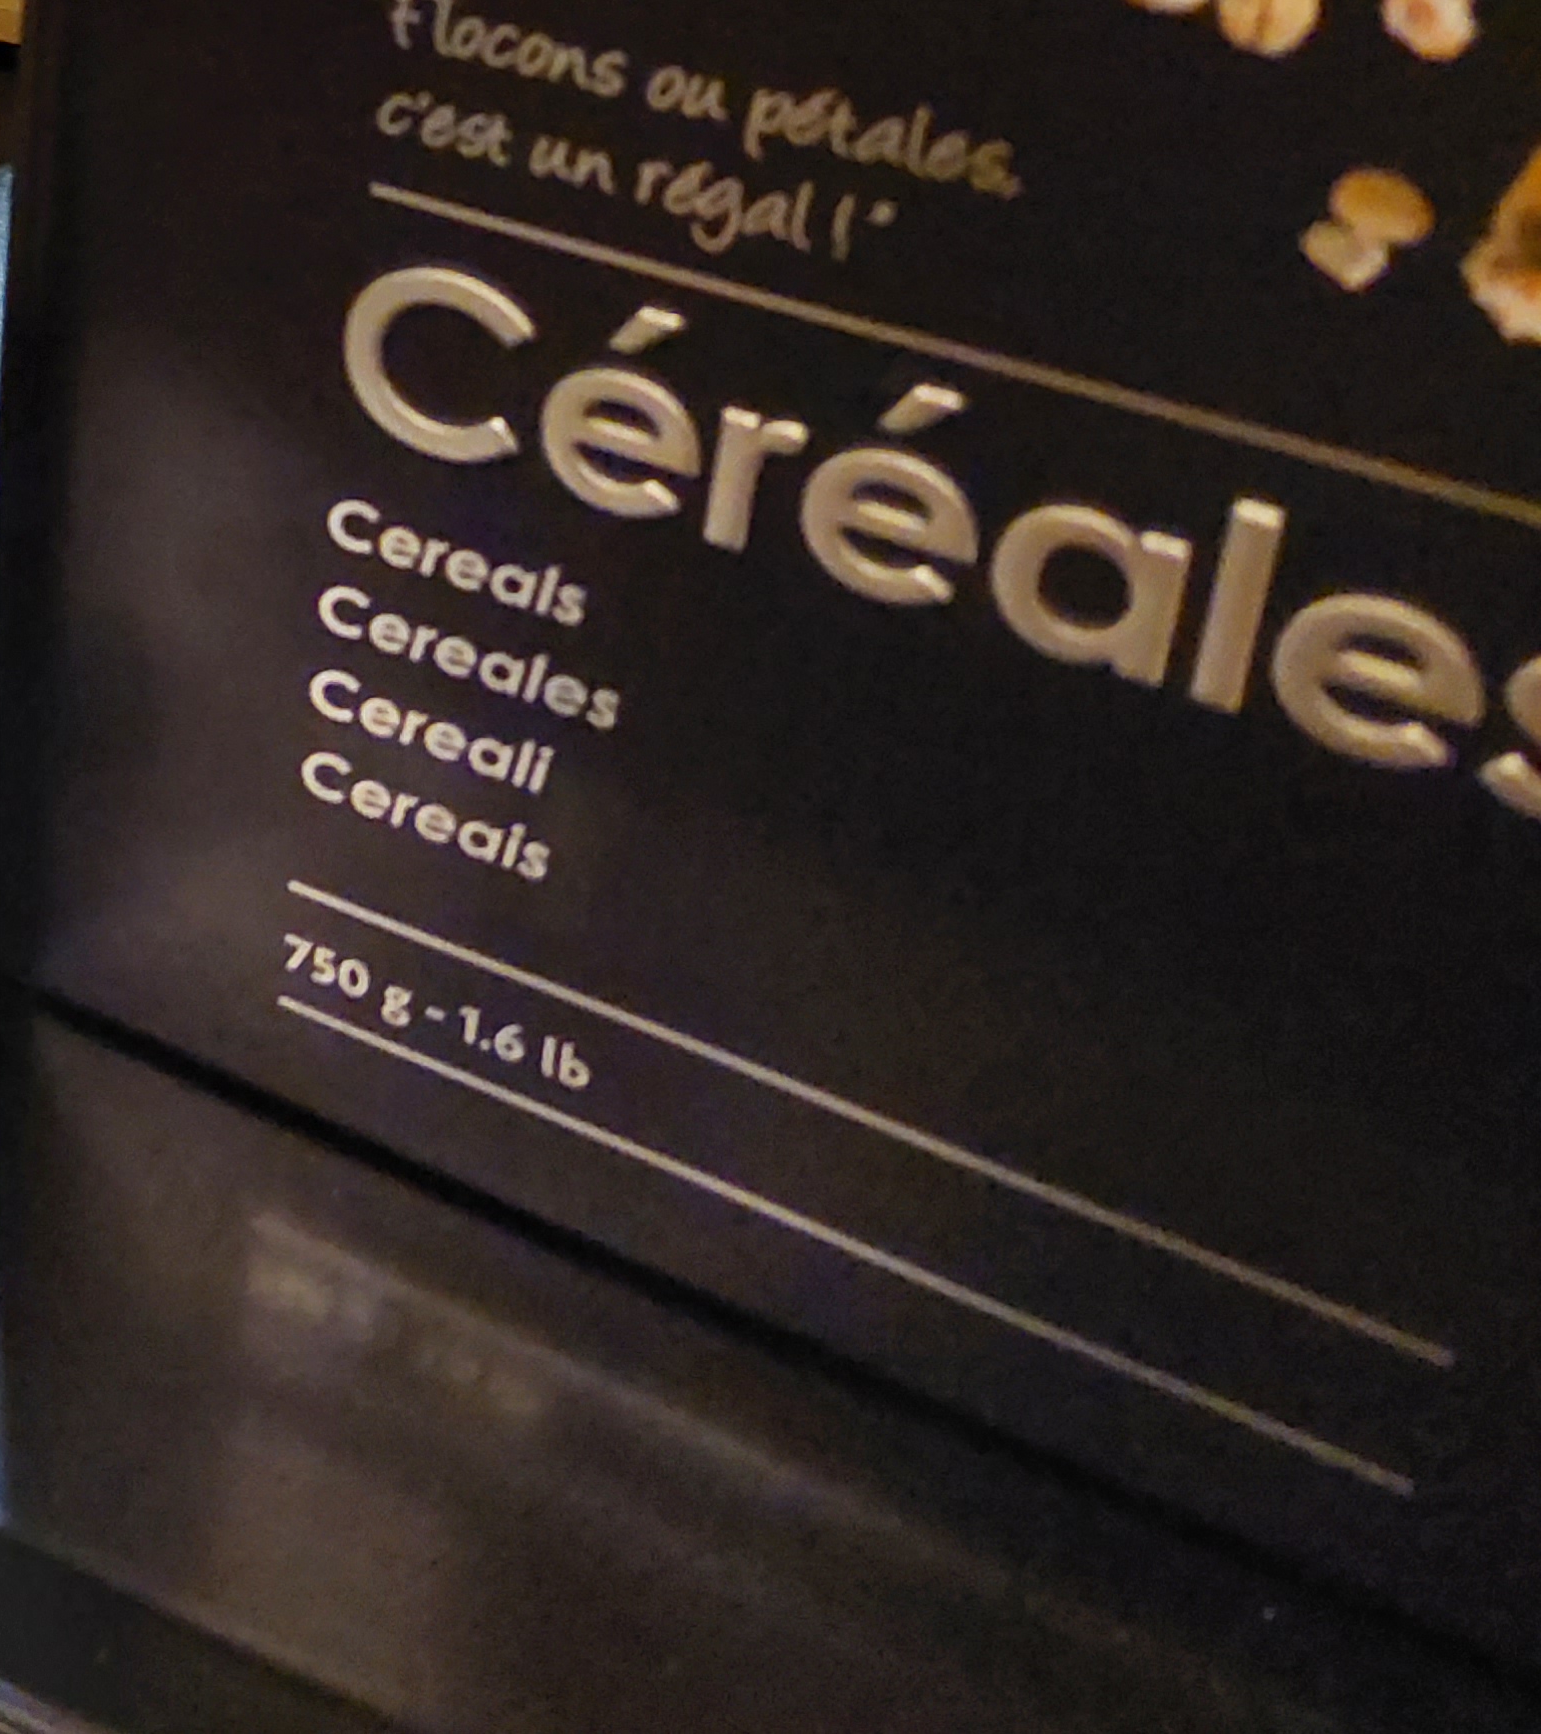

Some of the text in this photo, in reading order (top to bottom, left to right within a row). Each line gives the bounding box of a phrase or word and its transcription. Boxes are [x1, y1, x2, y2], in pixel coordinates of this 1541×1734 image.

[644, 64, 730, 123] ou
[374, 90, 514, 166] c'est
[527, 132, 617, 195] un
[633, 161, 814, 256] régal
[326, 498, 588, 627] Cereals
[317, 584, 621, 731] Cereales
[308, 668, 555, 795] Cereali
[283, 933, 371, 1000] 750
[379, 984, 415, 1028] g
[458, 1003, 526, 1063] 1.6
[539, 1035, 592, 1091] lb
